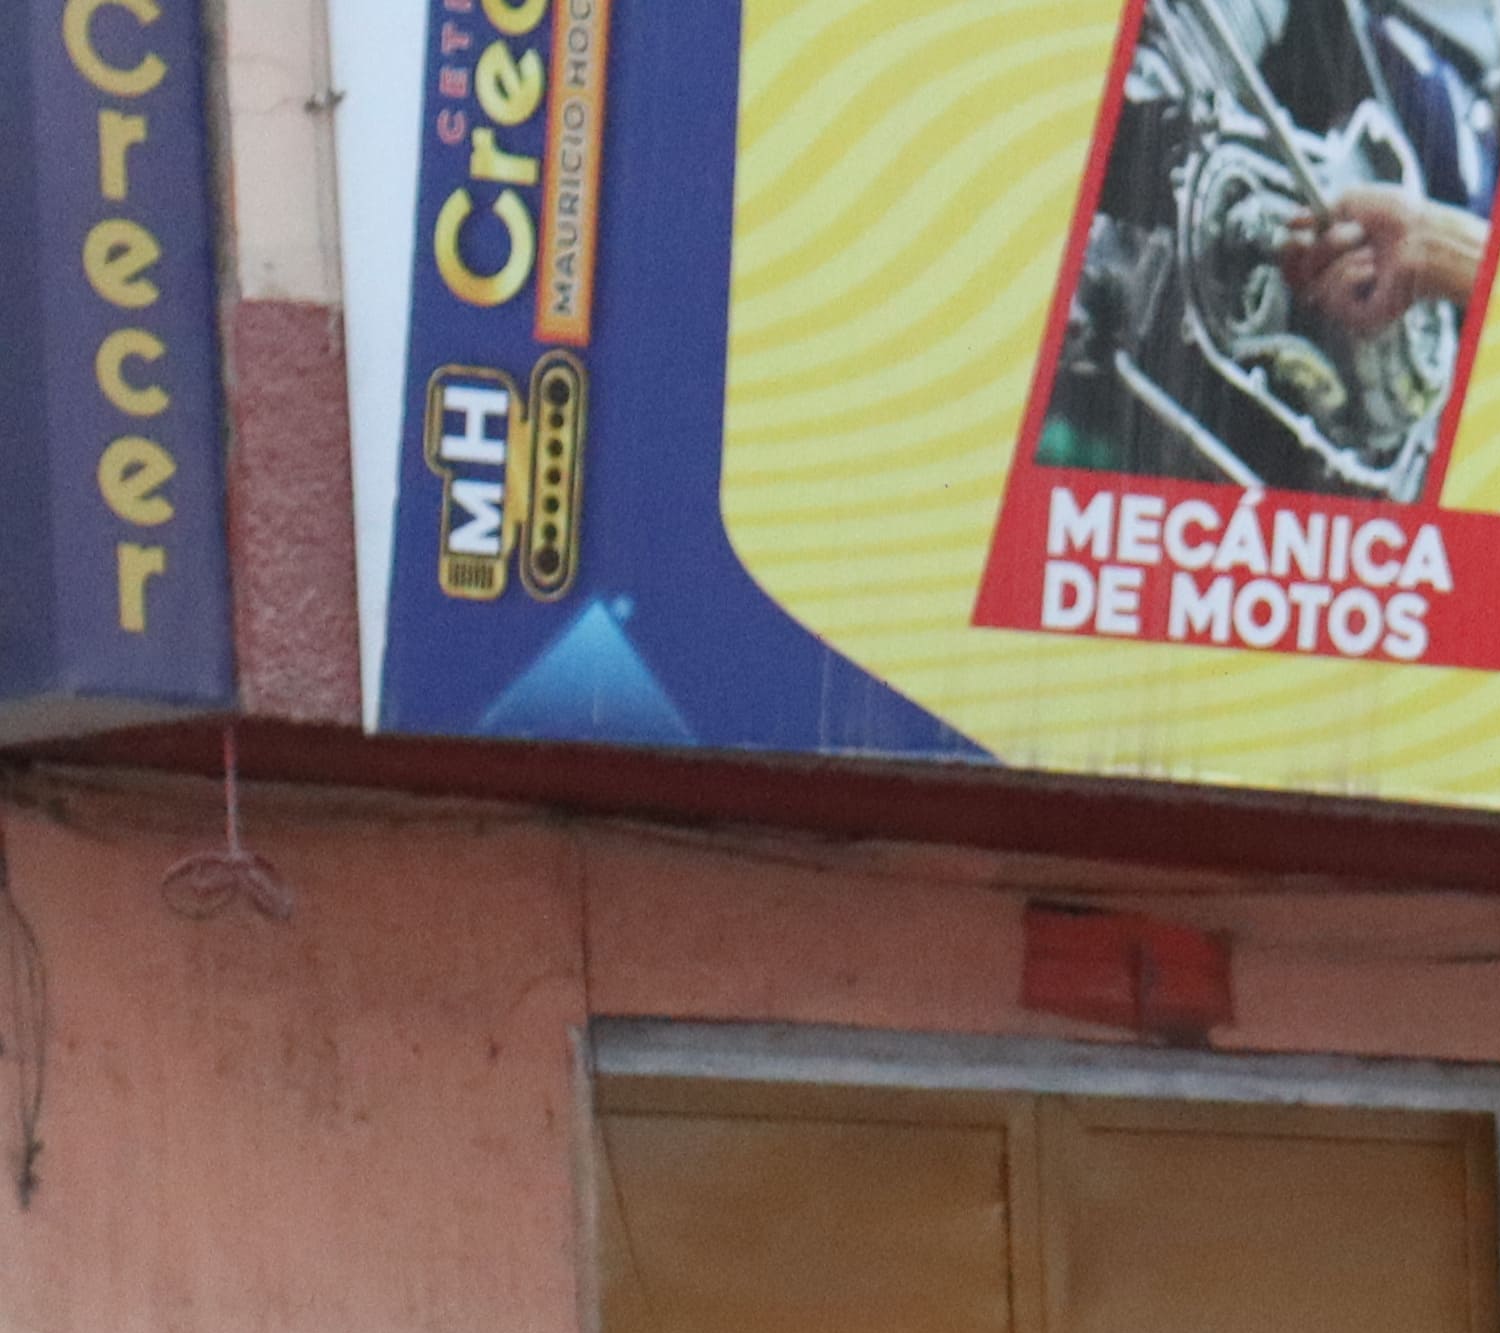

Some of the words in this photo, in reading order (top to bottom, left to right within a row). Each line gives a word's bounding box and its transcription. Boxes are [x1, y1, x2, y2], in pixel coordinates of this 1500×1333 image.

[554, 104, 588, 316] MAURICIO
[440, 384, 509, 556] MH
[1048, 488, 1453, 592] MECÁNICA
[1042, 562, 1142, 635] DE
[1168, 571, 1430, 660] MOTOS
